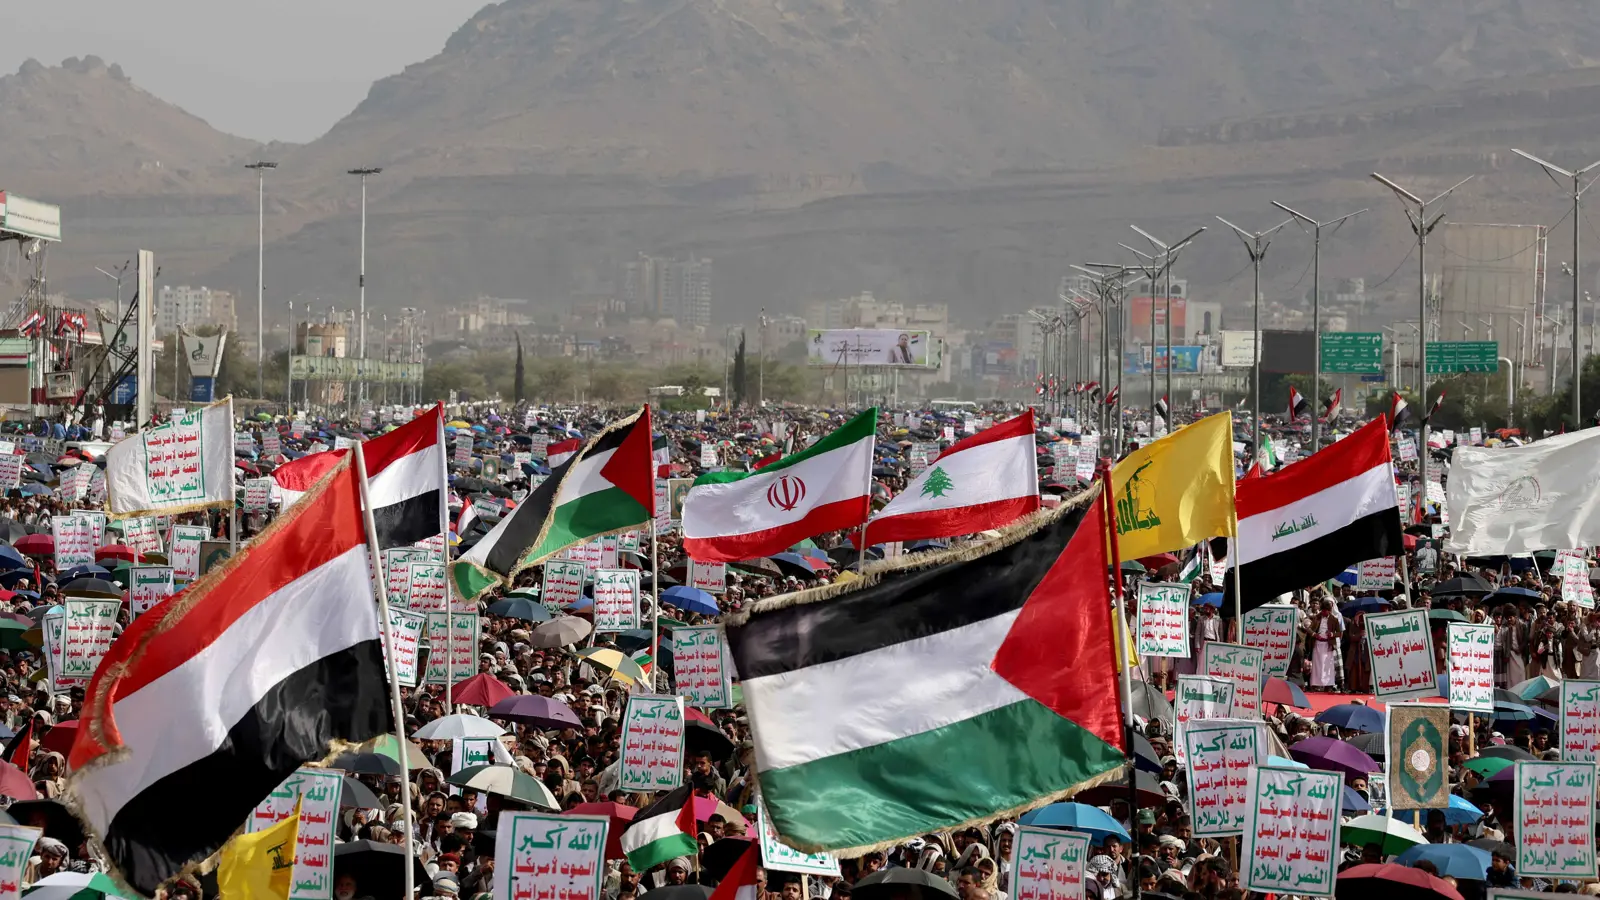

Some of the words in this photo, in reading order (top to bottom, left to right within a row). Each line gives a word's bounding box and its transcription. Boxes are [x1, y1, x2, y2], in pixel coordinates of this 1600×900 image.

[179, 412, 199, 426] الله
[177, 430, 199, 444] الموت
[177, 447, 199, 460] الموت
[148, 466, 168, 479] اليهود
[169, 465, 180, 478] على
[182, 462, 200, 473] اللعنة
[178, 476, 201, 495] النصر
[134, 570, 171, 587] قاطعوا
[1169, 591, 1185, 603] الله
[1166, 608, 1184, 616] الموت
[1166, 620, 1183, 629] الموت
[1370, 616, 1420, 640] قاطعوا
[703, 633, 719, 645] الله
[1141, 630, 1158, 640] اليهود
[1160, 632, 1168, 640] على
[1170, 631, 1184, 640] اللعنة
[1165, 642, 1185, 655] النصر
[1372, 640, 1400, 659] الأمريكية
[1402, 638, 1427, 656] البضائع
[701, 650, 719, 660] الموت
[1240, 653, 1258, 666] الله
[701, 664, 720, 674] الموت
[1398, 657, 1403, 670] و
[694, 677, 705, 688] على
[707, 677, 721, 686] اللعنة
[1236, 671, 1257, 681] الموت
[1378, 670, 1432, 691] الإسرائيلية
[676, 678, 693, 689] اليهود
[702, 688, 723, 705] النصر
[1181, 683, 1228, 704] قاطعوا
[1236, 687, 1257, 696] الموت
[1241, 701, 1257, 709] اللعنة
[659, 726, 682, 737] الموت
[657, 742, 679, 753] الموت
[1192, 730, 1227, 758] أكبر
[1229, 733, 1252, 750] الله
[1565, 740, 1588, 752] اليهود
[624, 755, 646, 767] اليهود
[647, 756, 658, 768] على
[660, 756, 678, 769] اللعنة
[653, 770, 676, 787] النصر
[1523, 766, 1564, 792] أكبر
[1566, 769, 1591, 787] الله
[305, 780, 335, 802] الله
[1260, 774, 1307, 800] أكبر
[1307, 779, 1335, 799] الله
[1196, 794, 1219, 809] اليهود
[1222, 794, 1234, 807] على
[1561, 795, 1590, 809] الموت
[299, 810, 331, 825] الموت
[1301, 807, 1333, 821] الموت
[1561, 814, 1589, 828] الموت
[297, 833, 329, 847] الموت
[516, 823, 568, 855] أكبر
[568, 827, 600, 850] الله
[1299, 829, 1331, 842] الموت
[1523, 832, 1548, 846] اليهود
[1550, 832, 1564, 847] على
[1568, 832, 1589, 845] اللعنة
[1021, 838, 1060, 863] أكبر
[1060, 842, 1083, 862] الله
[1255, 844, 1283, 861] اليهود
[1286, 847, 1302, 862] على
[1305, 846, 1329, 863] اللعنة
[303, 852, 328, 868] اللعنة
[1560, 850, 1590, 870] النصر
[560, 860, 596, 879] الموت
[1294, 866, 1328, 886] النصر
[292, 872, 327, 894] النصر
